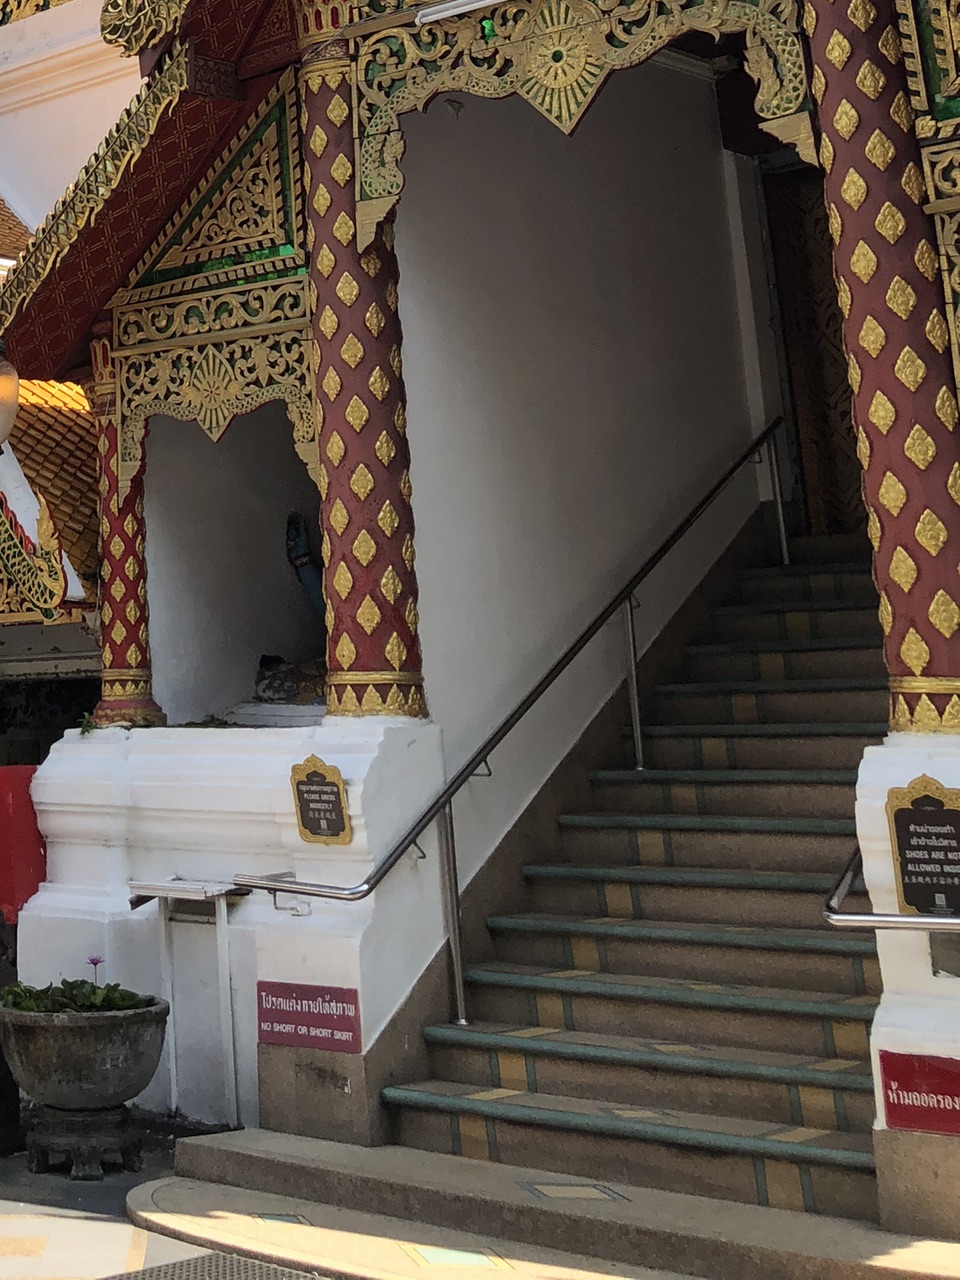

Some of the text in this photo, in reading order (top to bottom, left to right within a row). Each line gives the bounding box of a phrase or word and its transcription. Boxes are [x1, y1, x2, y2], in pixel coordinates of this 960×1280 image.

[906, 850, 928, 858] SHOES
[931, 851, 945, 859] ARE
[908, 863, 940, 872] ALLOWED
[261, 1022, 353, 1040] NO SHORT OR SHORT SKIRT
